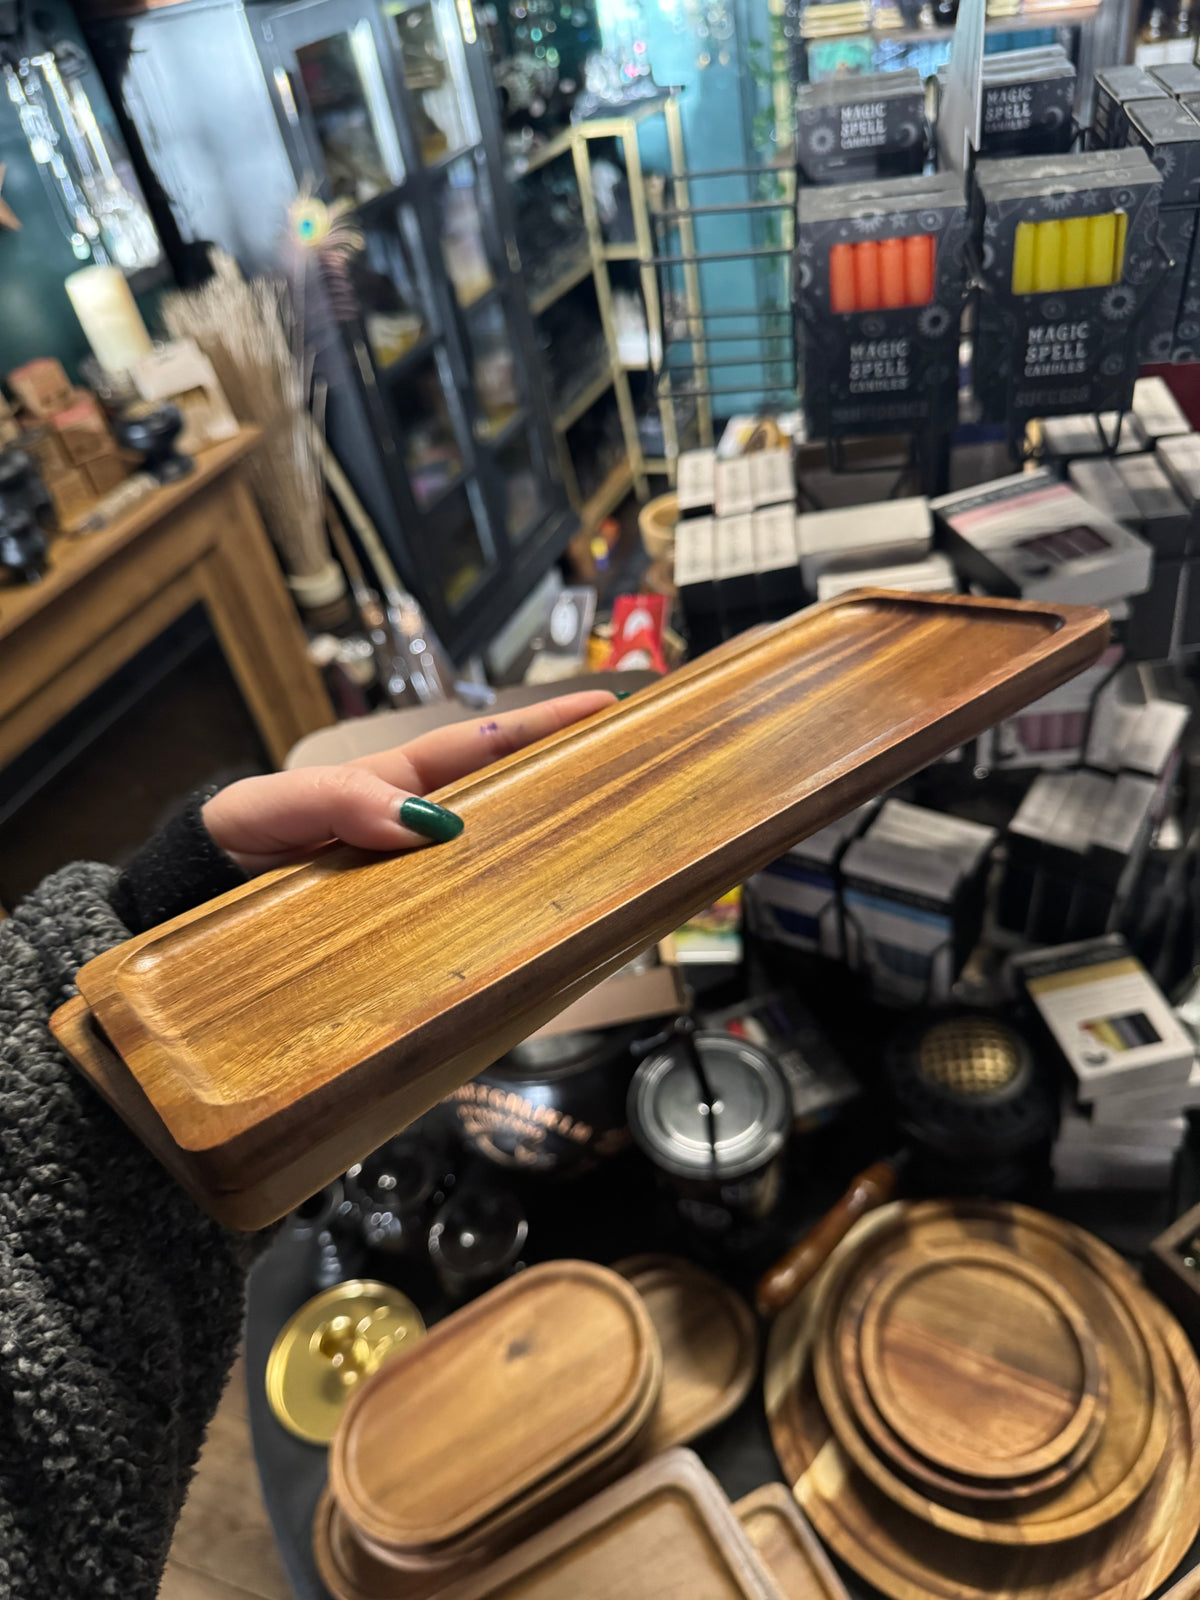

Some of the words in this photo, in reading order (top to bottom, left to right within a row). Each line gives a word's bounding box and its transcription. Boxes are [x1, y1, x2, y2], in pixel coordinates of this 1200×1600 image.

[986, 87, 1032, 106] MAGIC
[841, 102, 887, 121] MAGIC
[985, 101, 1032, 122] SPELL
[841, 119, 887, 138] SPELL
[1028, 321, 1089, 344] MAGIC
[849, 340, 910, 361] MAGIC
[1025, 340, 1088, 363] SPELL
[849, 359, 910, 380] SPELL
[1024, 360, 1087, 377] CANDLES
